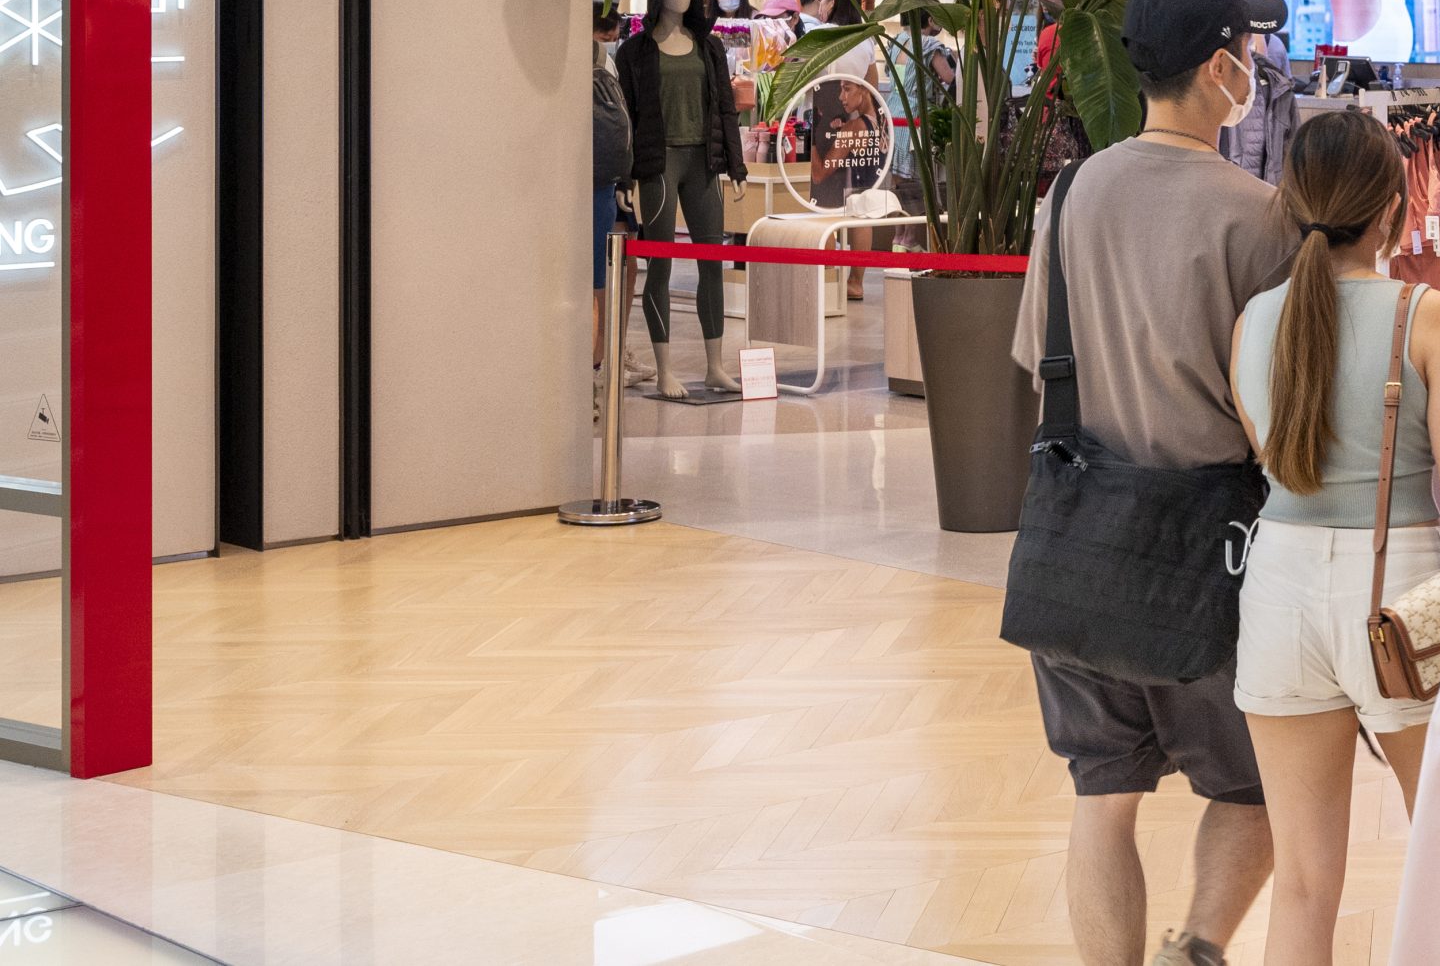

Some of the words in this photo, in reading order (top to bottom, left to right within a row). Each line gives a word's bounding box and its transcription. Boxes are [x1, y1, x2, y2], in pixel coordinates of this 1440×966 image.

[834, 137, 880, 149] EXPRESS
[852, 147, 880, 157] YOUR
[824, 157, 880, 169] STRENGTH
